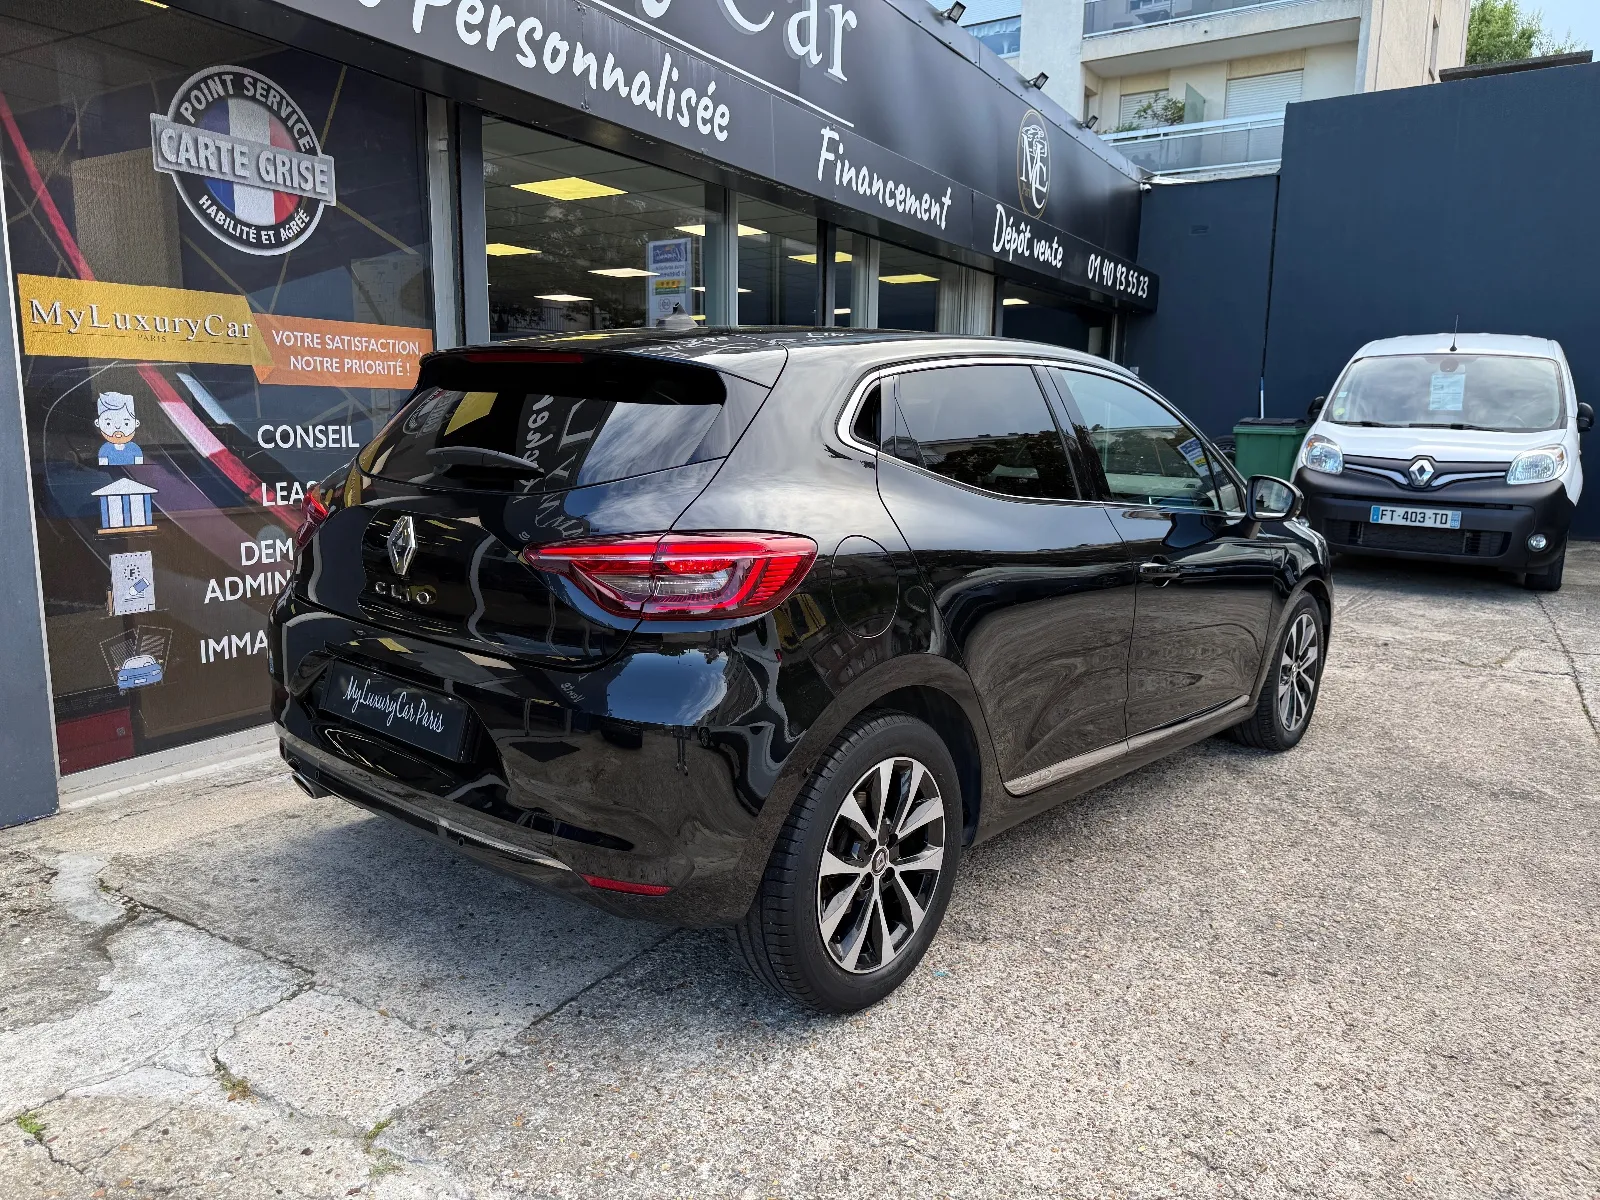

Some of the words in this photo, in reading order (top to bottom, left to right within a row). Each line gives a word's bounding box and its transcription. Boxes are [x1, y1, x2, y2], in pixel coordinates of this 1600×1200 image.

[719, 0, 858, 82] ar
[180, 74, 234, 124] POINT
[243, 77, 314, 152] SERVICE
[160, 128, 250, 178] CARTE
[258, 150, 329, 195] GRISE
[817, 125, 952, 230] Financement
[198, 194, 257, 243] HABILITÉ
[261, 230, 276, 244] ET
[280, 207, 310, 242] AGRÉÉ
[993, 203, 1031, 262] Dépôt
[1034, 236, 1063, 269] vente
[1087, 253, 1101, 283] 01
[1102, 258, 1114, 287] 40
[1116, 263, 1126, 291] 93
[1127, 269, 1137, 294] 55
[1138, 275, 1149, 299] 23
[28, 298, 253, 341] MyLuxuryCar
[137, 334, 167, 343] PARIS
[272, 329, 322, 348] VOTRE
[325, 334, 422, 357] SATISFACTION,
[290, 356, 341, 373] NOTRE
[344, 359, 404, 376] PRIORITÉ
[257, 424, 360, 449] CONSEIL
[375, 581, 430, 605] CLIO
[416, 698, 445, 733] Paris
